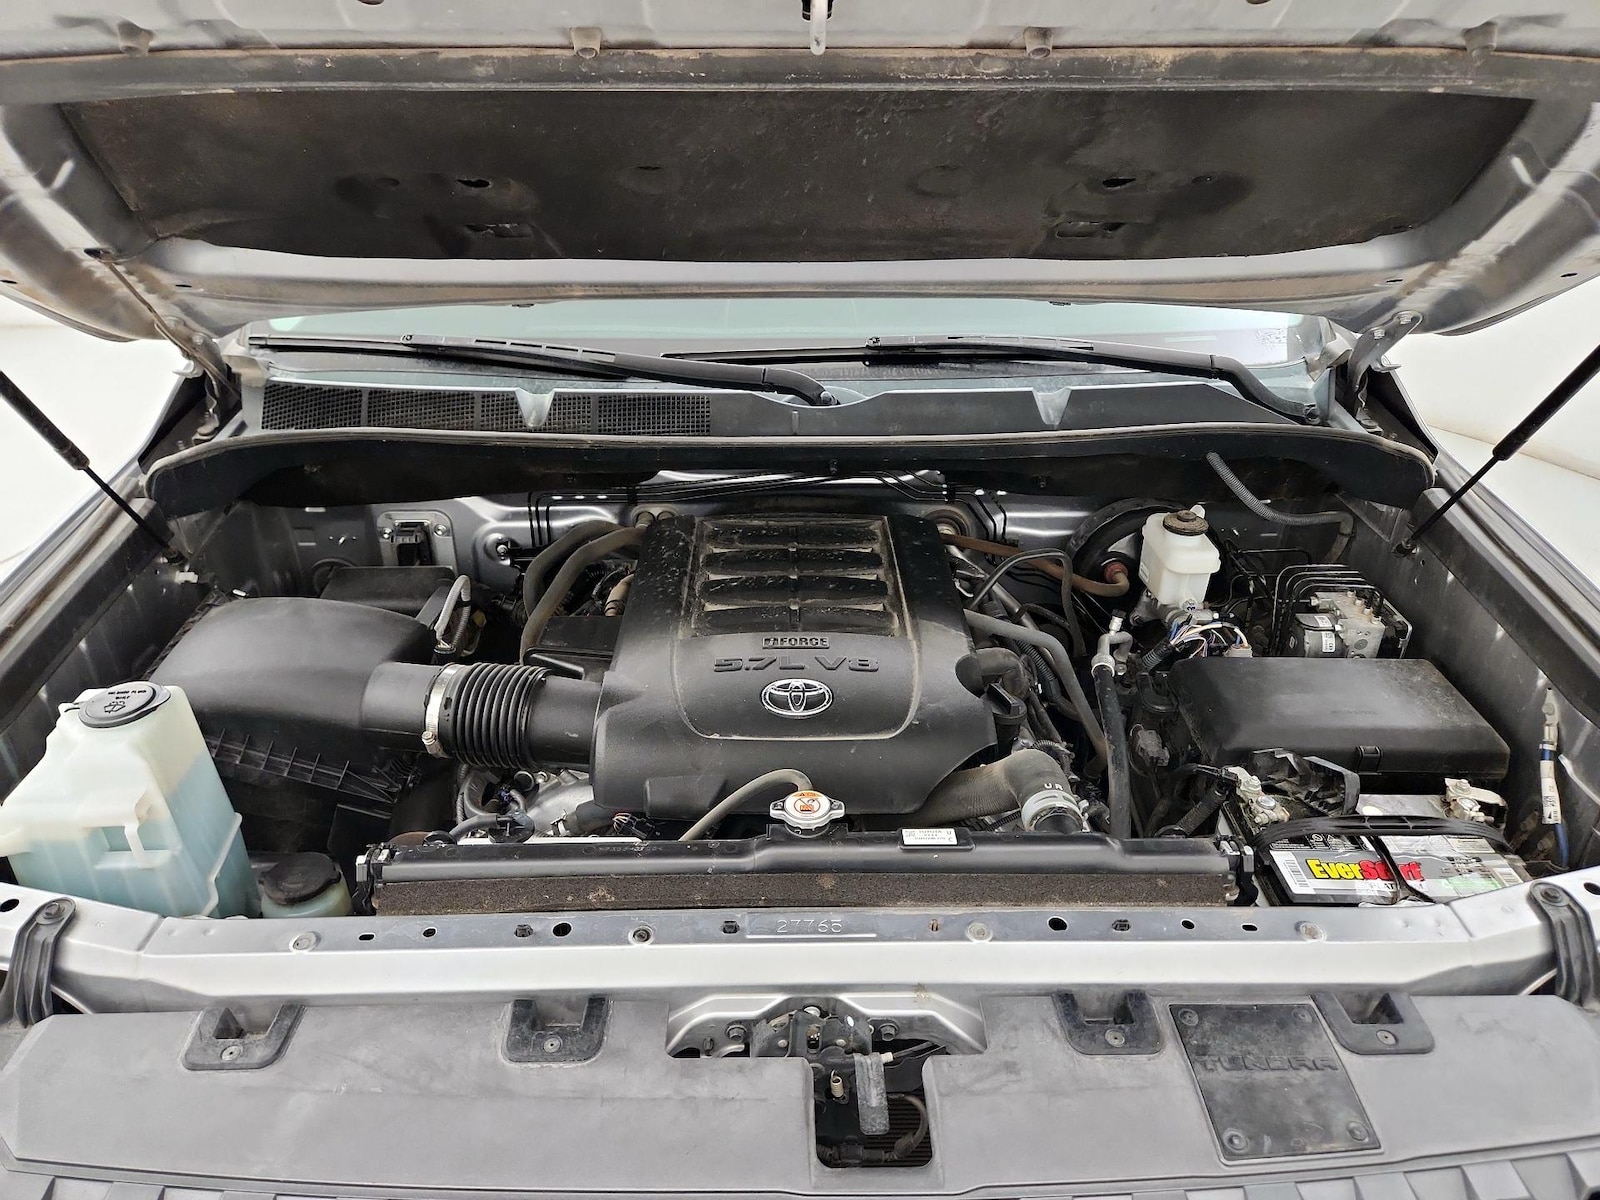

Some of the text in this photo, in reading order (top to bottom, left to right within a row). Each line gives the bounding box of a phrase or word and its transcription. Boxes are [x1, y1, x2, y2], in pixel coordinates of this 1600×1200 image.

[714, 655, 879, 672] 5.7L V8
[776, 919, 842, 933] 27765
[1195, 1055, 1339, 1071] TUNDRA
